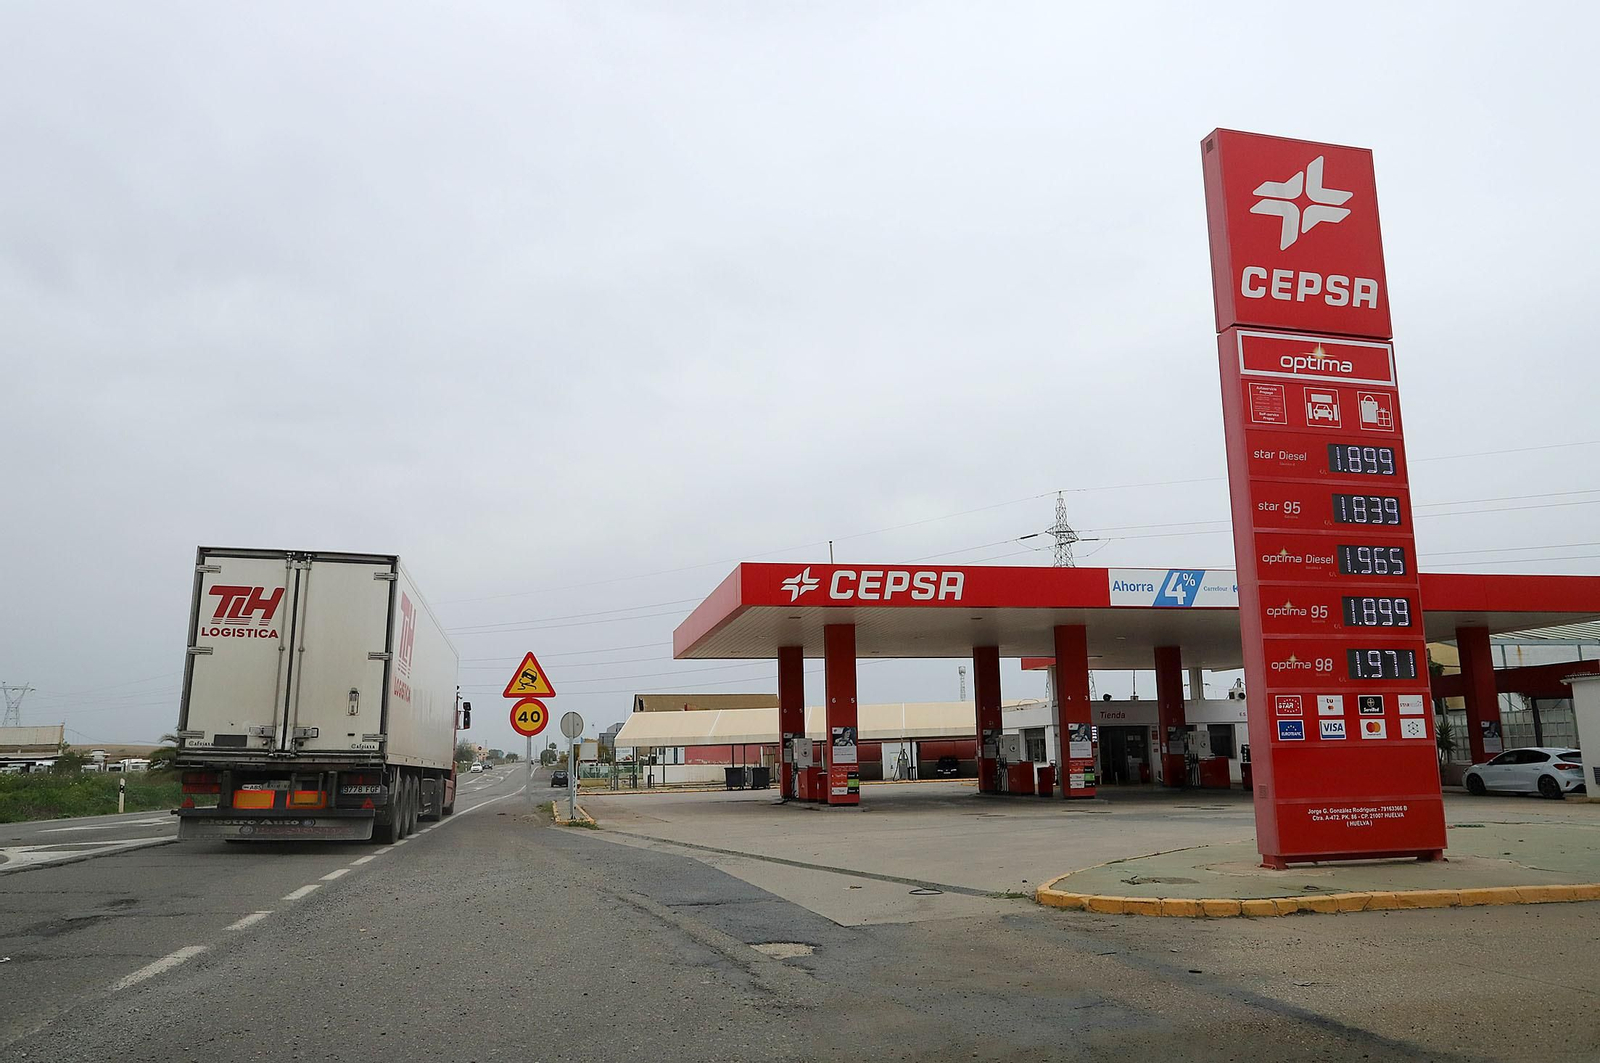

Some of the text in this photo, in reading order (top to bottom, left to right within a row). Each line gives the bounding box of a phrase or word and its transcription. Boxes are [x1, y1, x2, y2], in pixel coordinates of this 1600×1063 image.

[1241, 266, 1378, 309] CEPSA
[1280, 354, 1353, 373] optima
[1253, 450, 1307, 461] star Diesel
[1336, 446, 1394, 475] 1.899
[1258, 501, 1301, 515] star 95
[1341, 496, 1399, 525] 1.839
[1262, 553, 1334, 565] optima Diesel
[1345, 547, 1404, 575] 1.965
[829, 570, 965, 600] CEPSA
[1112, 580, 1154, 592] Ahorra
[1266, 605, 1328, 619] optima 95
[1350, 598, 1409, 626] 1.899
[201, 627, 279, 639] LOGISTICA
[1271, 658, 1333, 672] optima 98
[1355, 650, 1415, 678] 1.971
[518, 711, 541, 723] 40
[1100, 711, 1126, 719] Tienda
[1323, 723, 1344, 732] VISA
[343, 784, 363, 794] 9778
[1308, 808, 1322, 816] Jorge
